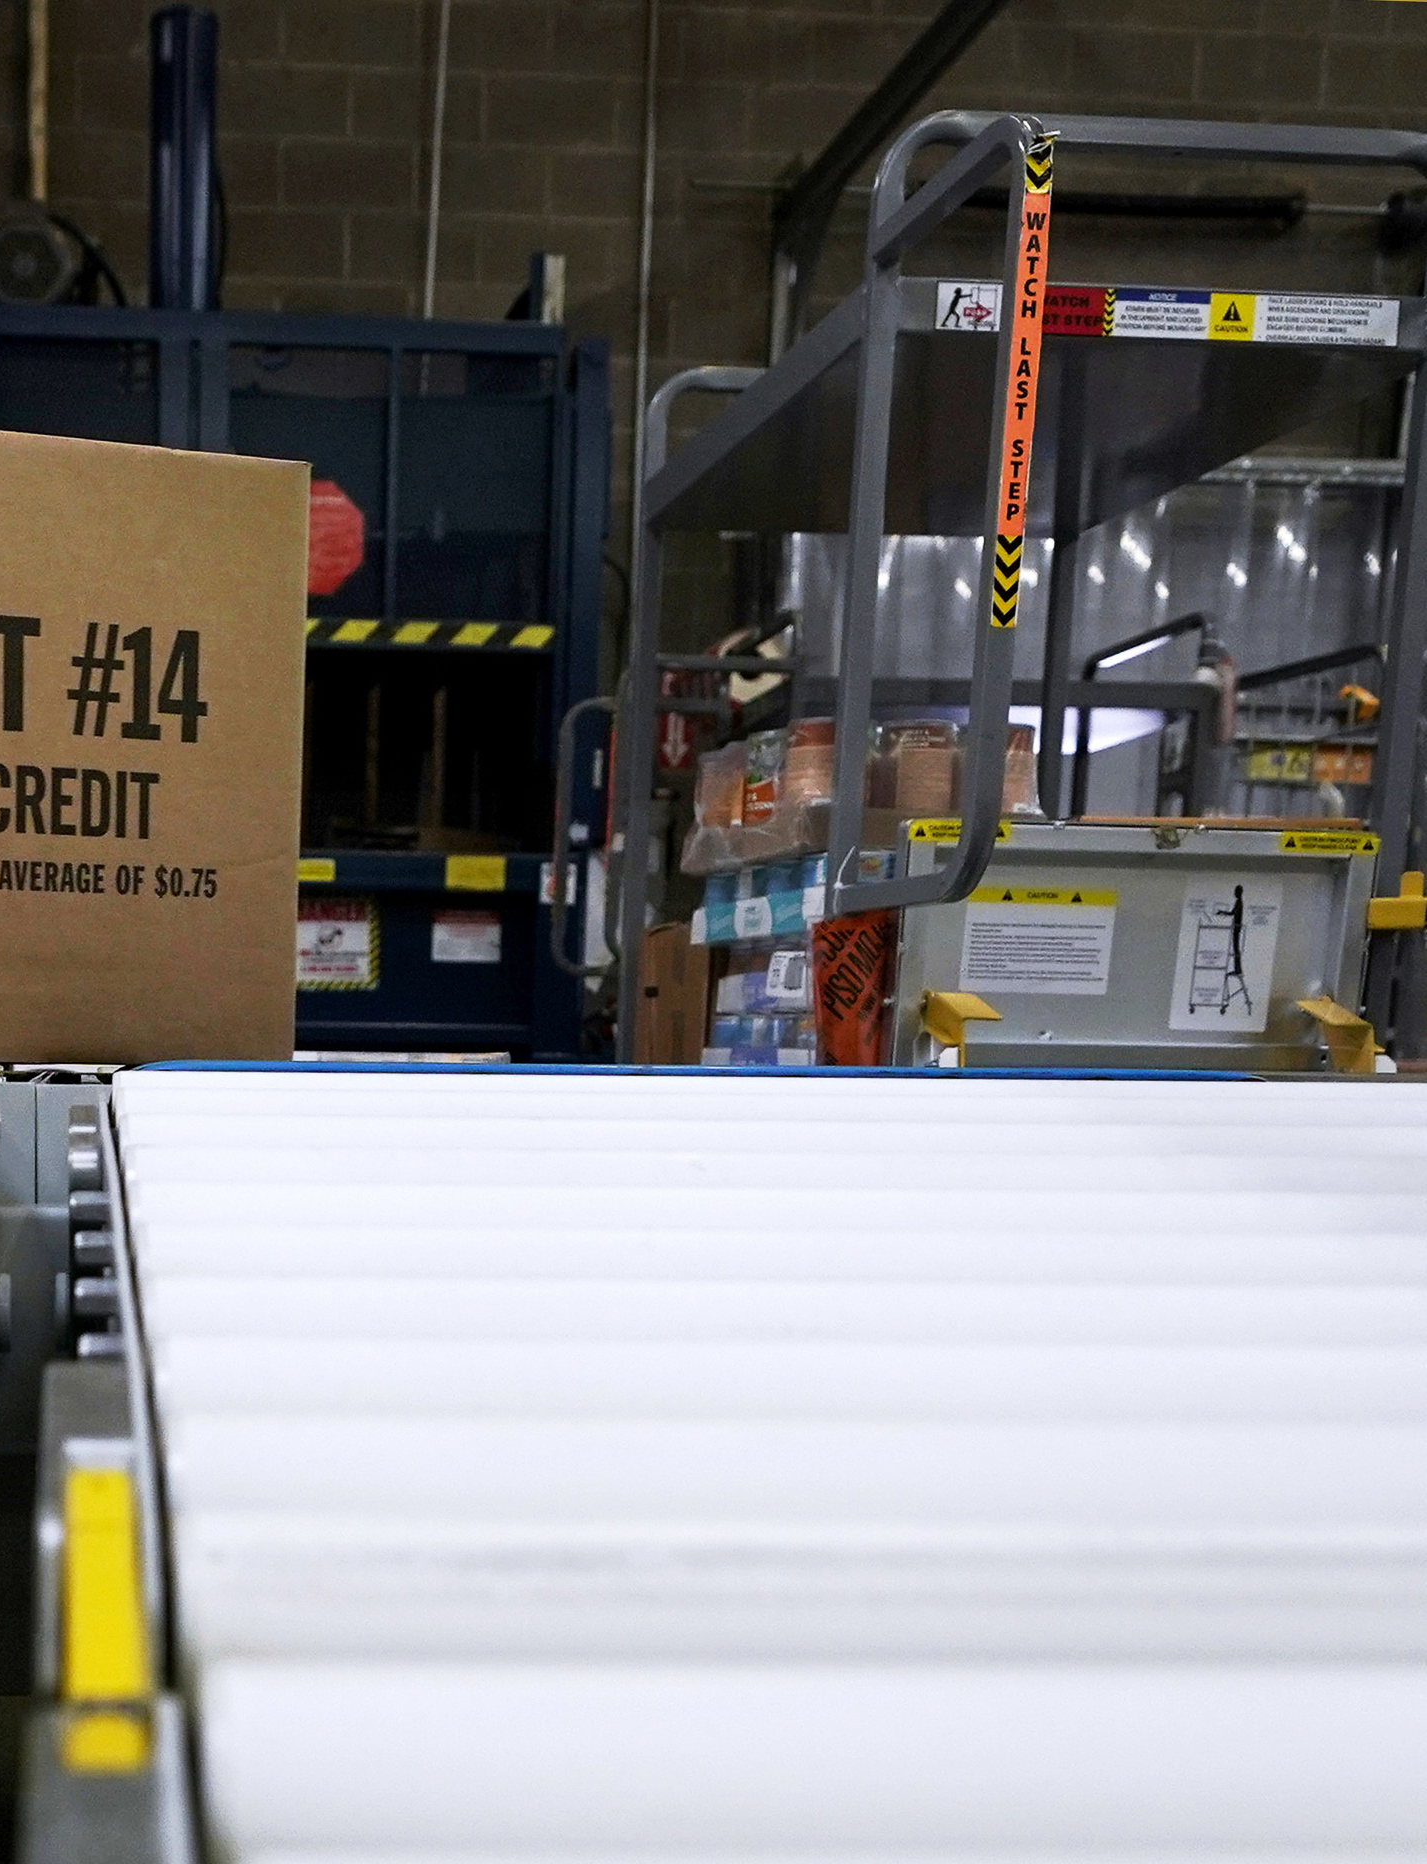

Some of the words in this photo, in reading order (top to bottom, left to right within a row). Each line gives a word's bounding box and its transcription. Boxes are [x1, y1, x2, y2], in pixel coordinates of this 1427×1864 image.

[1022, 211, 1047, 319] WATCH
[1066, 315, 1103, 327] STEP
[1015, 337, 1032, 420] LAST
[1006, 439, 1024, 522] STEP
[66, 621, 209, 743] #14
[115, 864, 145, 896] OF
[154, 864, 218, 898] $0.75
